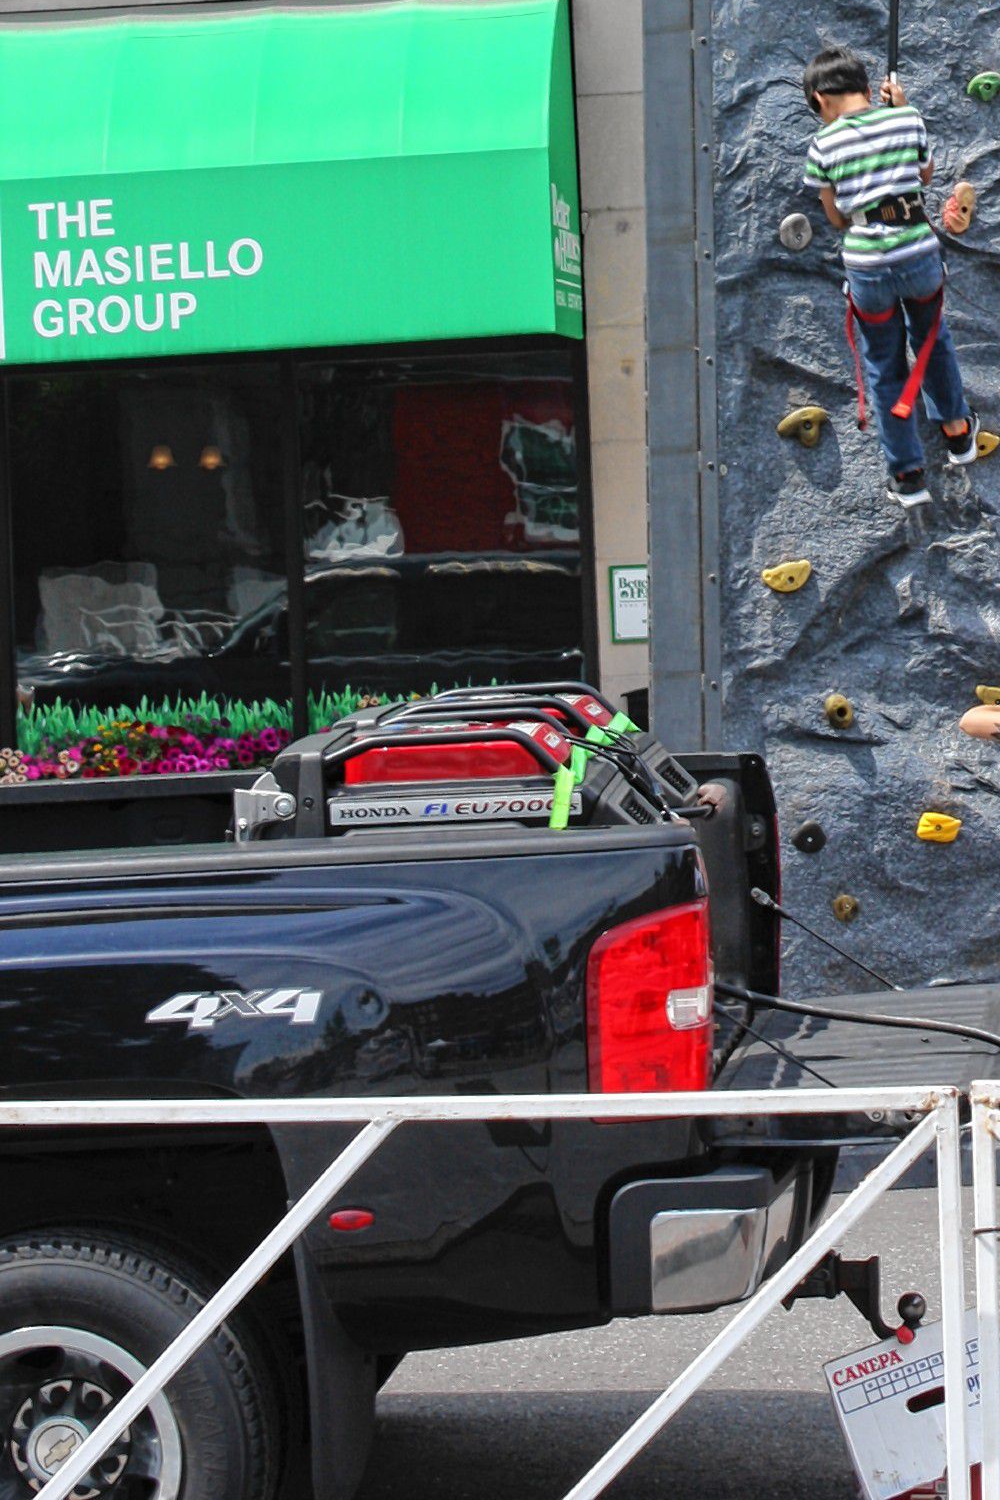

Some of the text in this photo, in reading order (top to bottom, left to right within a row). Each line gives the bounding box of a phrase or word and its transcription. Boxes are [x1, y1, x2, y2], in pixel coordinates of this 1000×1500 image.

[28, 199, 115, 240] THE
[33, 238, 264, 289] MASIELLO
[33, 292, 197, 338] GROUP
[340, 806, 412, 819] HONDA
[833, 1350, 903, 1386] CANEPA
